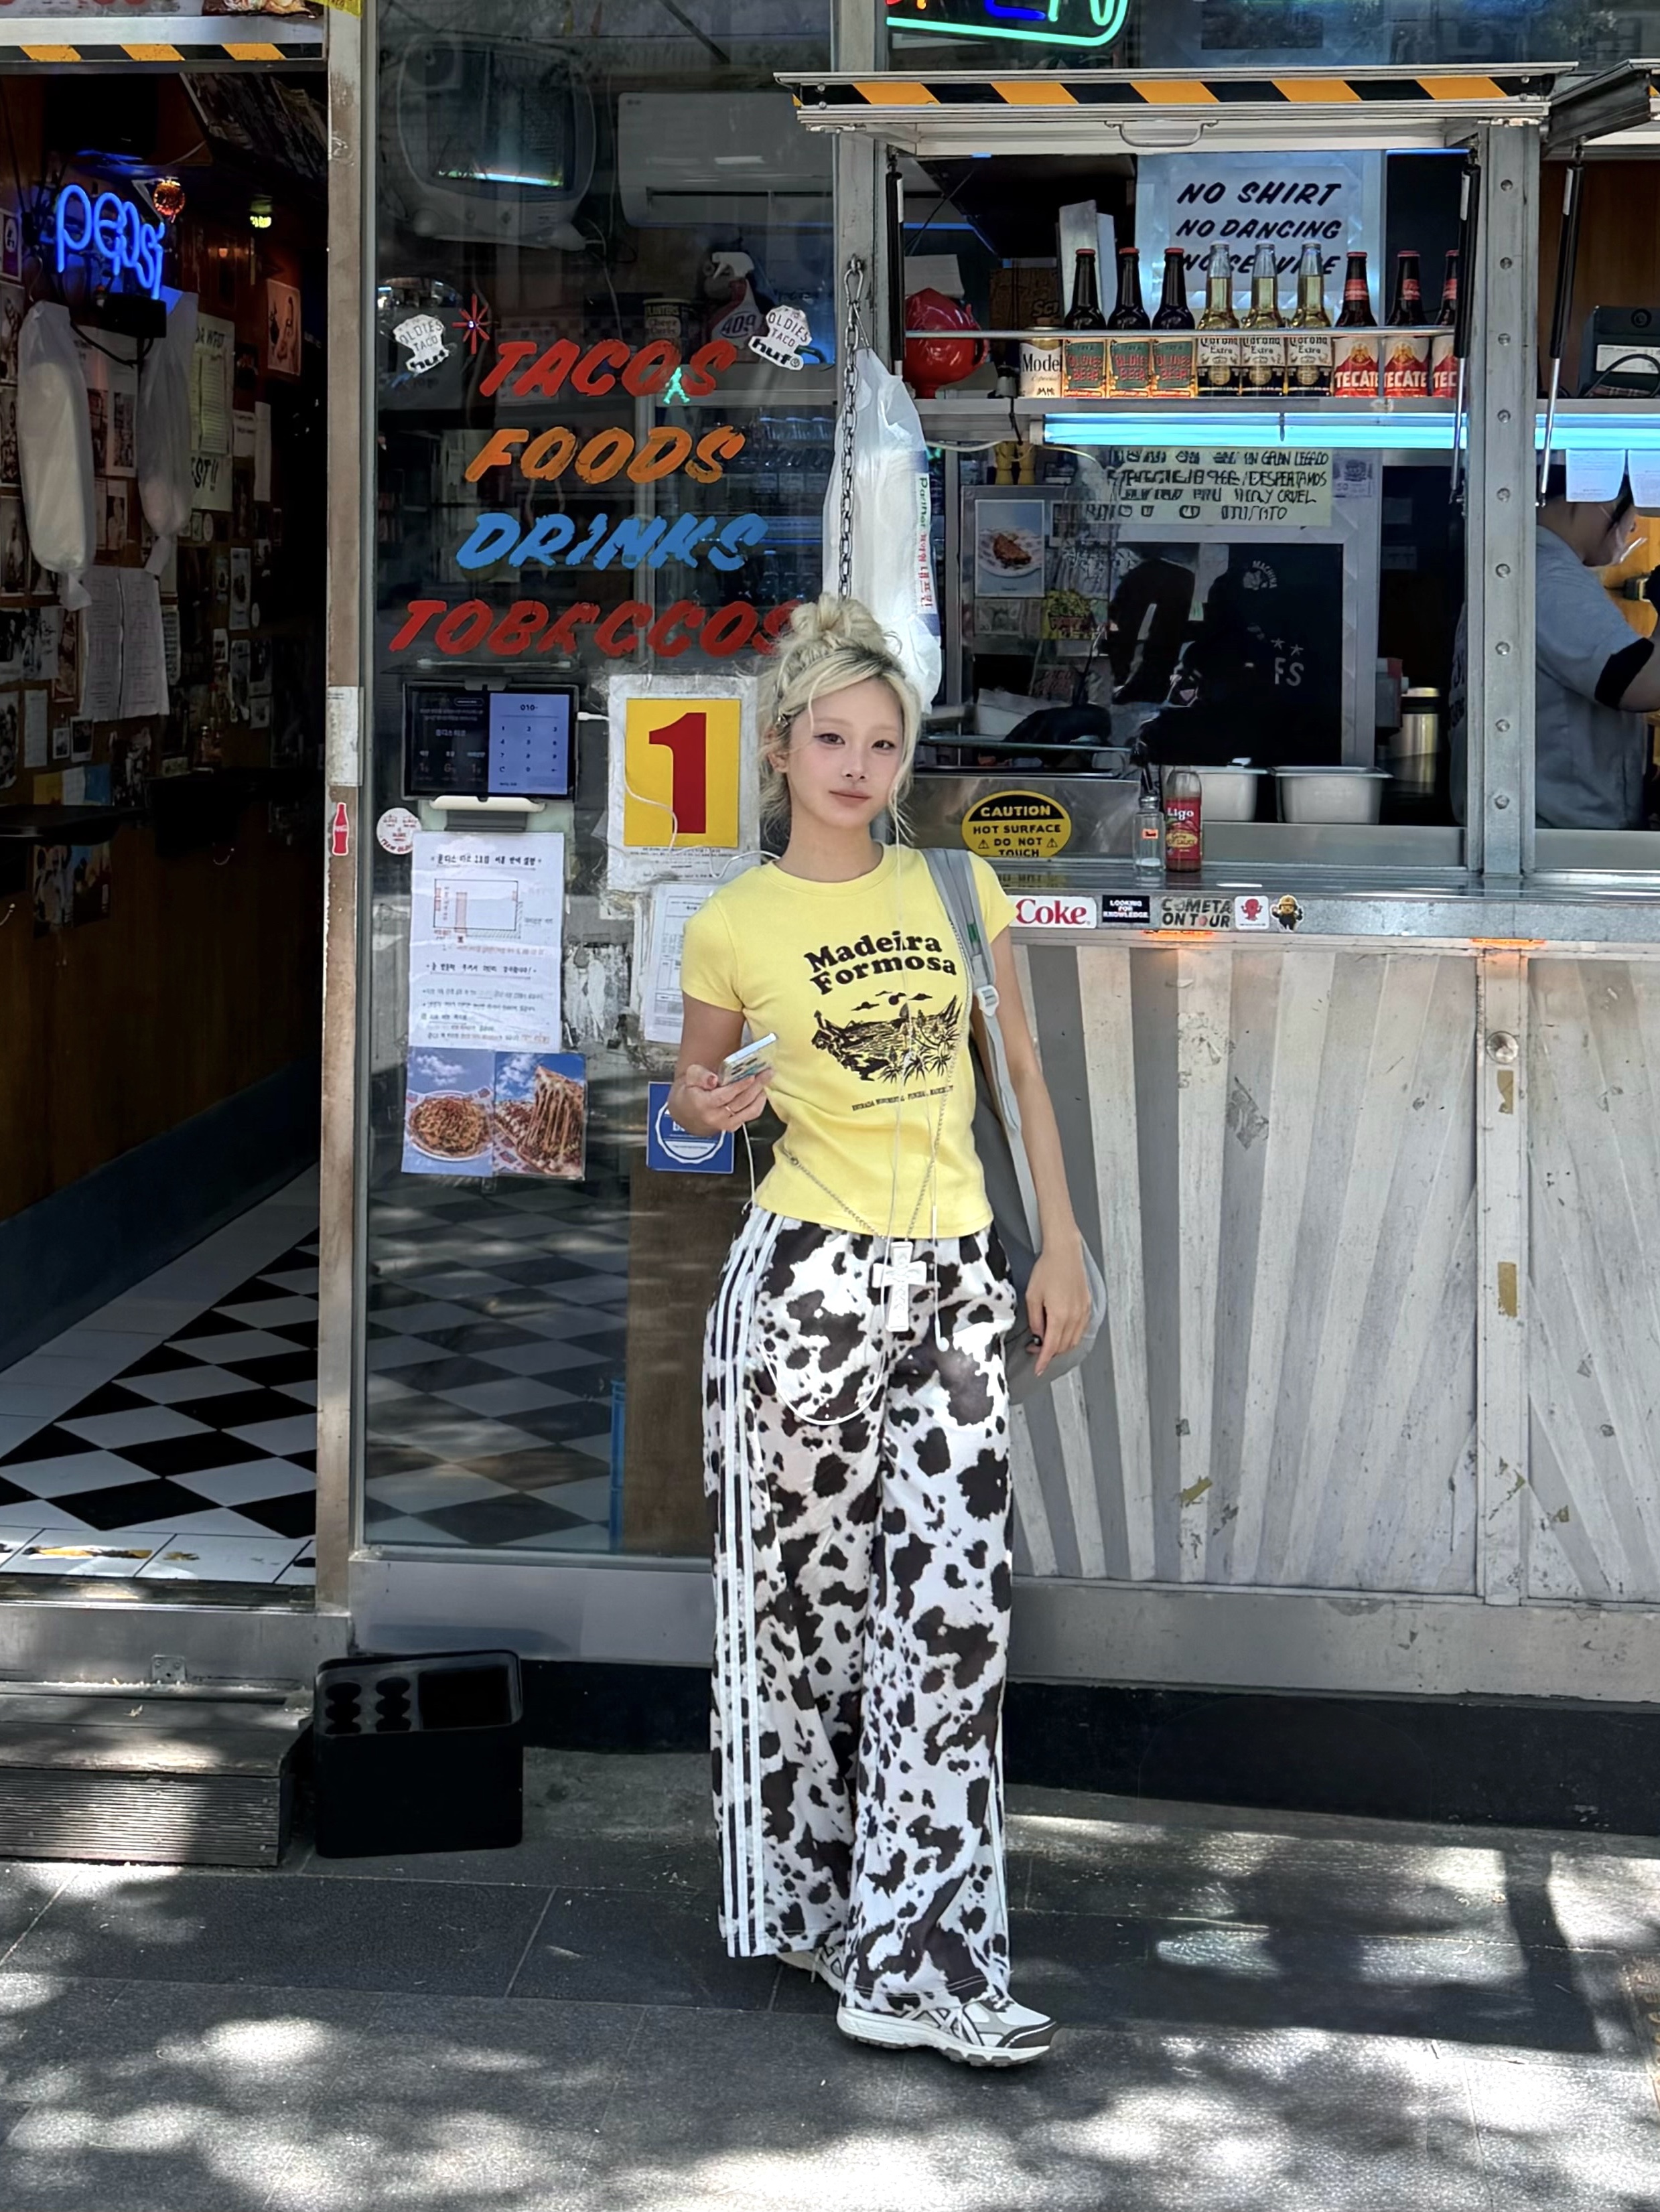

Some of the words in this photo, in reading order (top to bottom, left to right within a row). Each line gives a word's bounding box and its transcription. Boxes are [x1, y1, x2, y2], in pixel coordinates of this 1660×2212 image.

[1177, 181, 1226, 204] NO
[1237, 181, 1342, 206] SHIRT
[1176, 219, 1216, 238] NO
[1220, 218, 1342, 239] DANCING
[399, 320, 443, 344] OLDIES
[768, 311, 809, 343] OLDIES
[413, 336, 438, 352] TACO
[771, 328, 796, 348] TACO
[1210, 346, 1233, 354] Extra
[1251, 346, 1273, 354] Extra
[1298, 346, 1320, 354] Extra
[479, 338, 737, 397] TACOS
[464, 426, 746, 484] FOODS
[456, 513, 768, 571] DRINKS
[648, 712, 707, 834] 1
[980, 805, 1051, 817] CAUTION
[1167, 807, 1194, 820] Ligo
[973, 826, 999, 834] HOT
[1004, 824, 1061, 834] SURFACE
[1018, 838, 1042, 846] NOT
[999, 849, 1039, 857] TOUCH
[1016, 898, 1087, 925] Coke
[1162, 898, 1232, 913] COMETA
[1162, 913, 1185, 926] ON
[1190, 913, 1231, 928] TOUR
[804, 930, 943, 973] Madeira
[809, 956, 957, 995] Formosa
